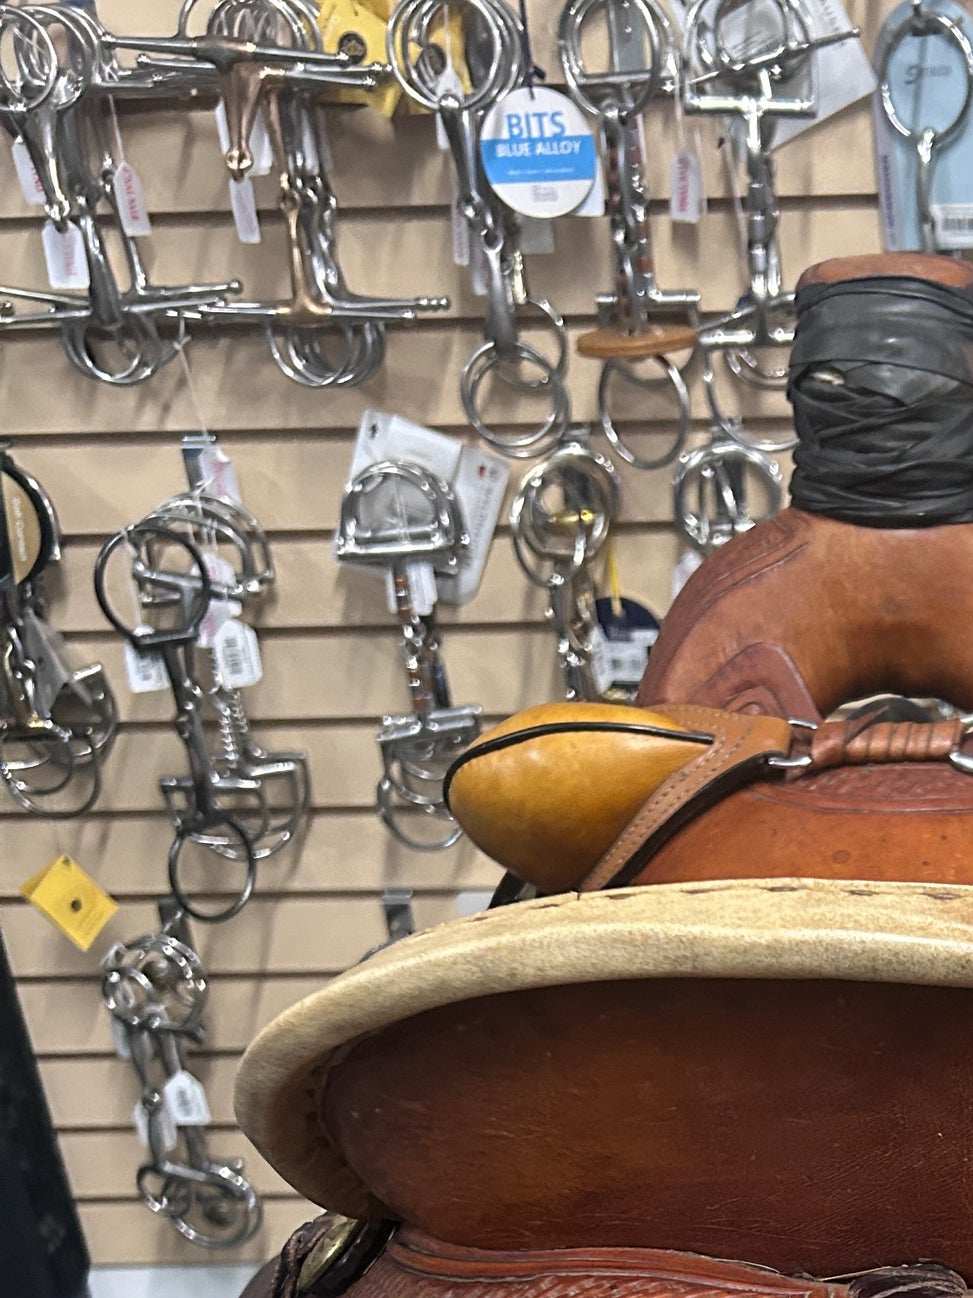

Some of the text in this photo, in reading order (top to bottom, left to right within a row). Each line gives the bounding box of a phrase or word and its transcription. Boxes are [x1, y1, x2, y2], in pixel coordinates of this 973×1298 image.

[506, 111, 566, 139] BITS
[496, 141, 582, 157] BLUE ALLOY
